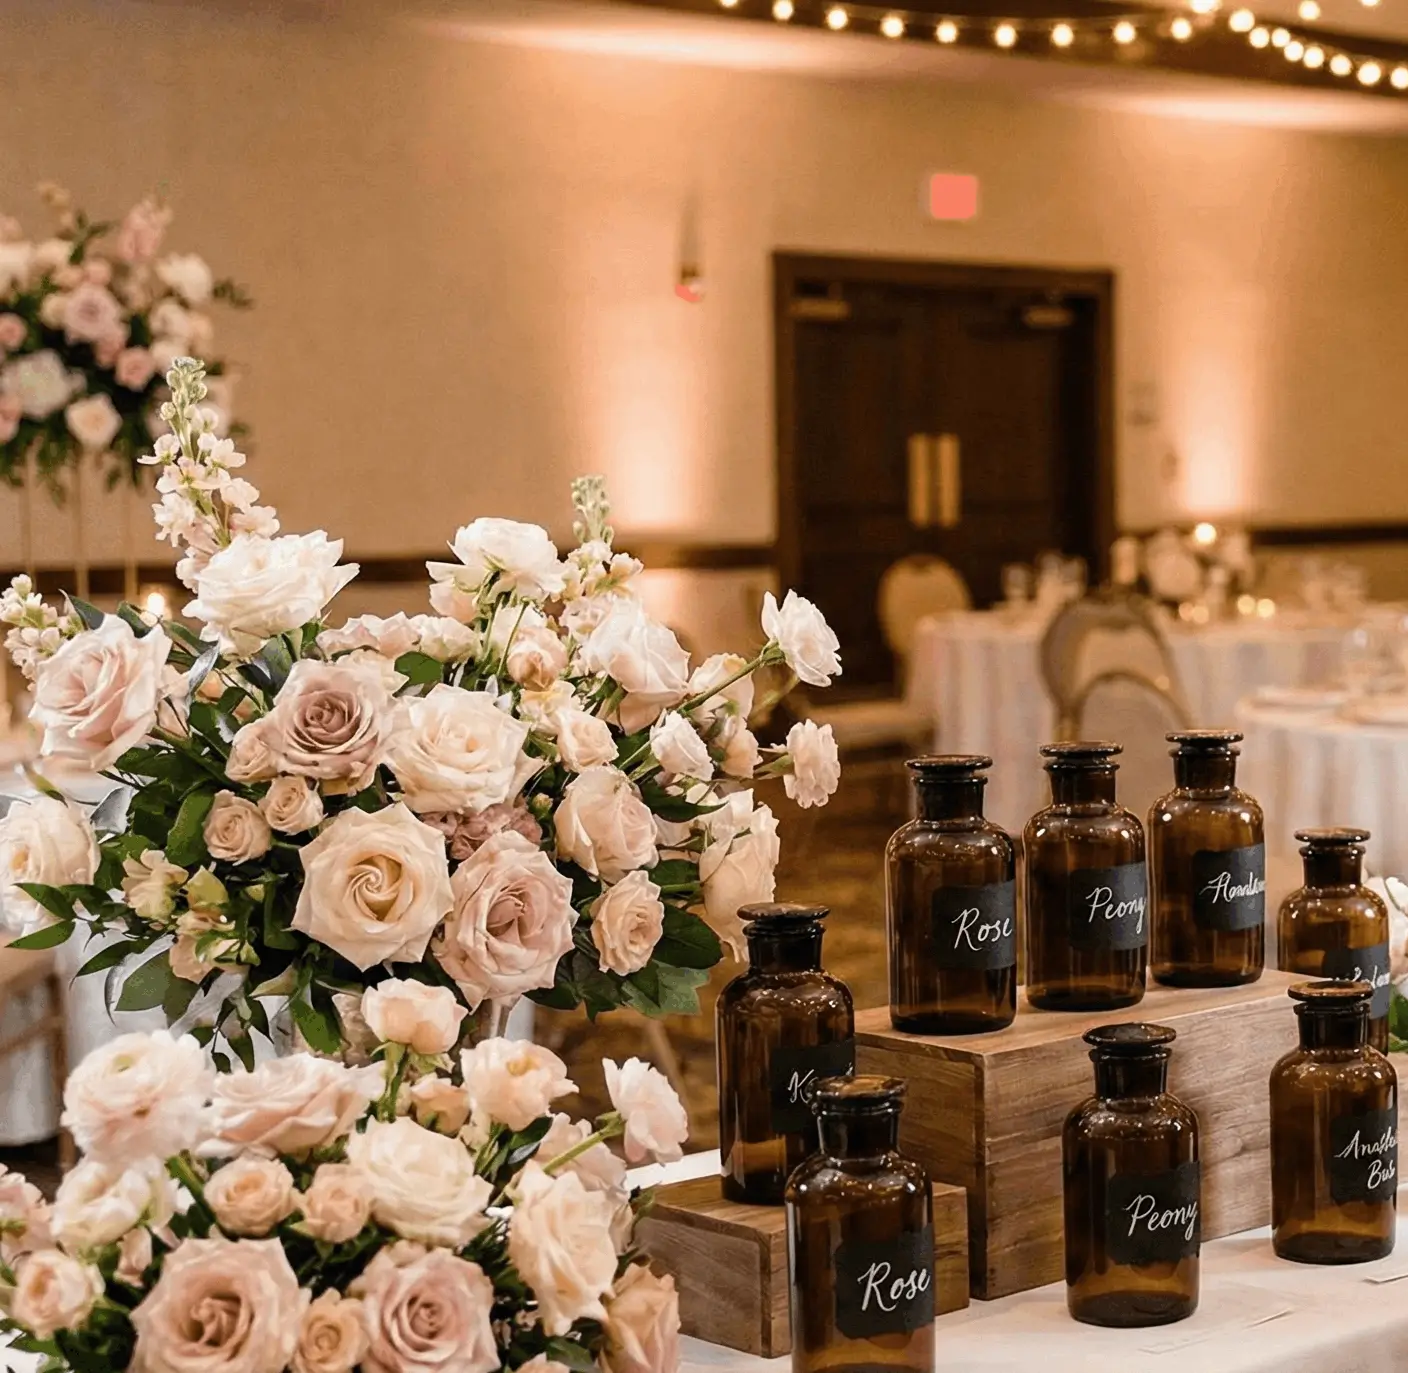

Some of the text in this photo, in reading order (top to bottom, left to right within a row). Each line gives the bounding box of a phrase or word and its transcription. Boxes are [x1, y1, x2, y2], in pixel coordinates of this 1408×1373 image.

[951, 907, 1013, 951] Rose
[1085, 886, 1147, 935] Peony
[1121, 1194, 1198, 1241] Peony
[857, 1262, 931, 1312] Rose
